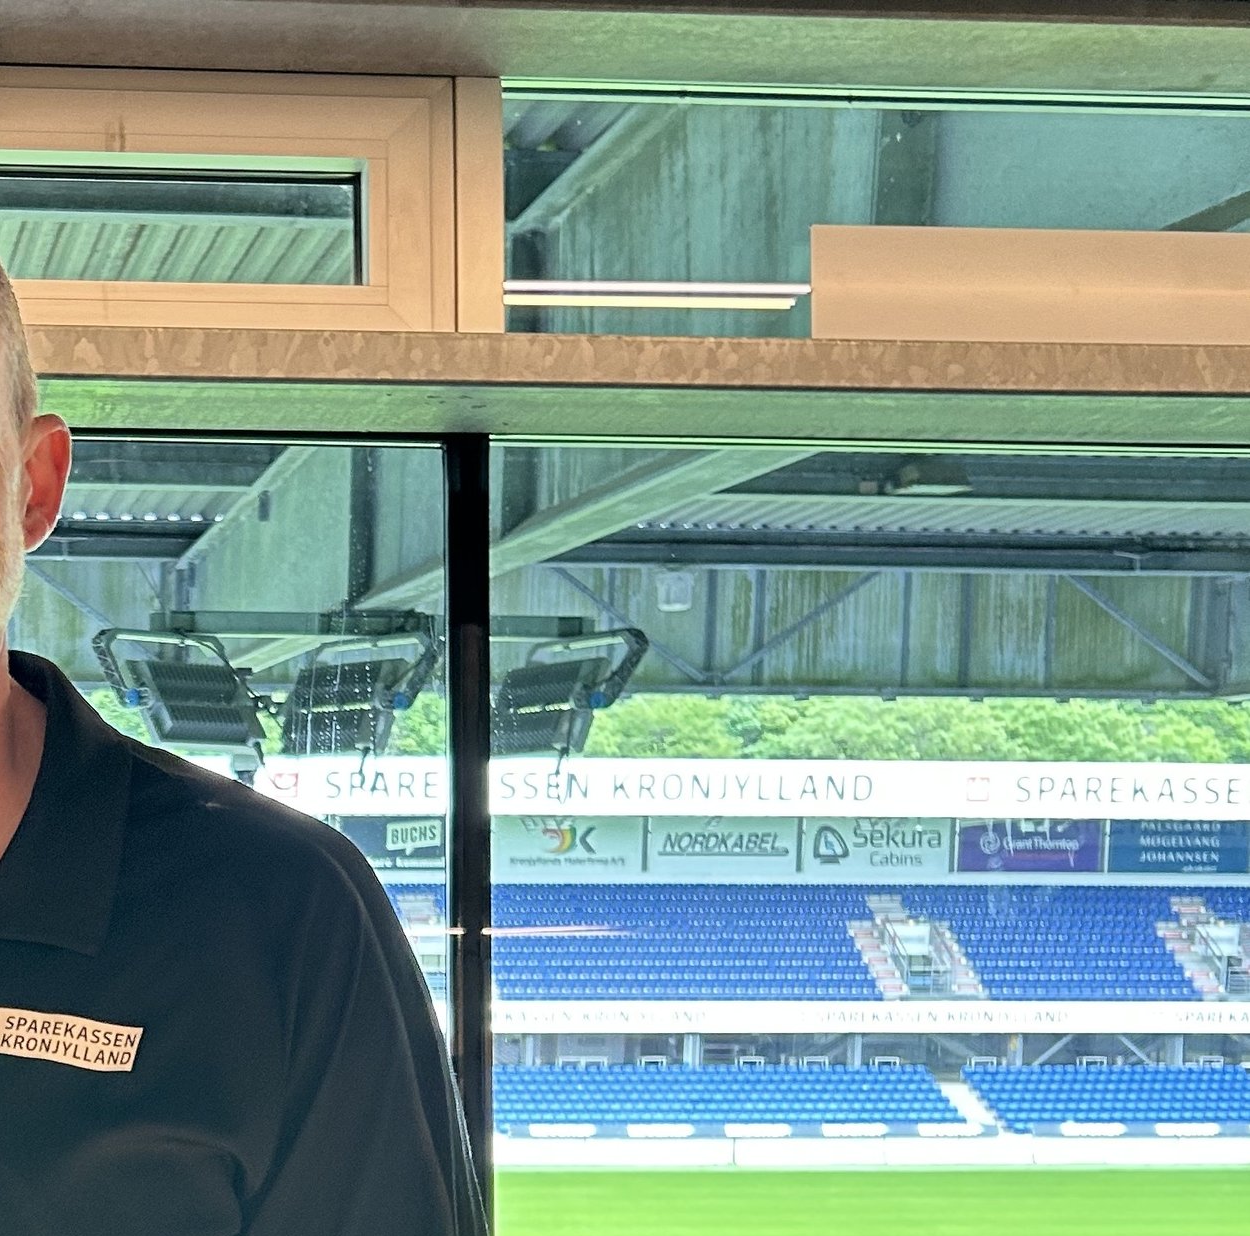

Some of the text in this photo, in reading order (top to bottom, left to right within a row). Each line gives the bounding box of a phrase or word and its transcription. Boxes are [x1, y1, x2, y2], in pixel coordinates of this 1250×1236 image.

[613, 774, 873, 801] KRONJYLLAND
[1016, 776, 1250, 804] SPAREKASSE
[390, 824, 438, 845] BUCHS
[662, 831, 781, 852] NORDKABEL
[853, 822, 942, 849] Sekura
[869, 850, 922, 867] Cabins
[4, 1015, 138, 1049] SPAREKASSEN
[0, 1033, 132, 1066] KRONJYLLAND
